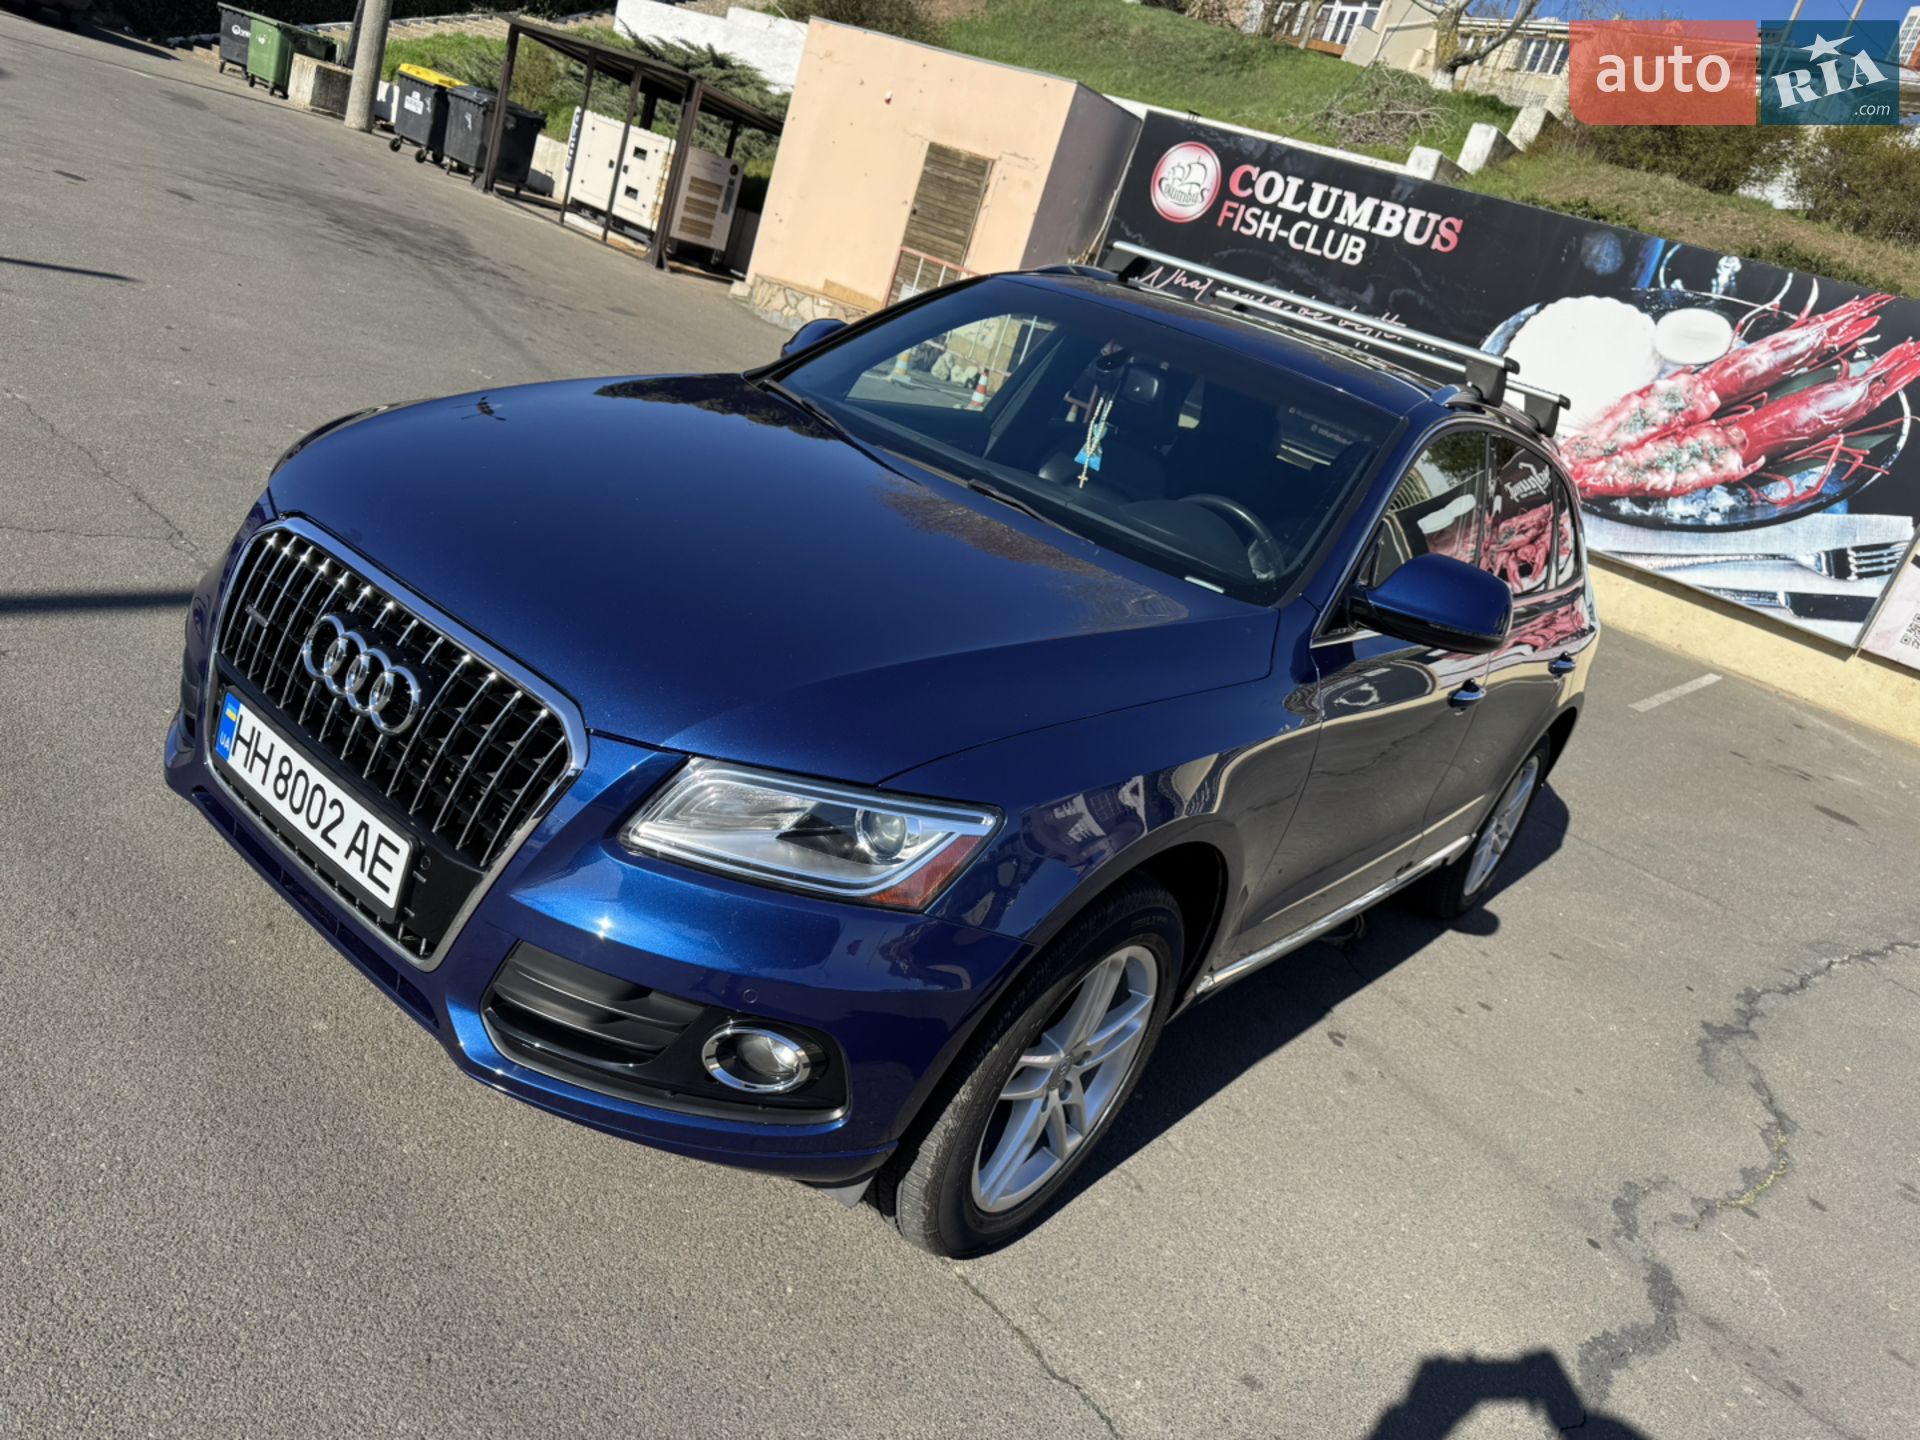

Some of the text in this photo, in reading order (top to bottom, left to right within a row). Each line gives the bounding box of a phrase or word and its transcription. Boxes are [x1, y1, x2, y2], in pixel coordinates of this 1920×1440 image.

[1216, 200, 1367, 266] FISH-CLUB
[1228, 163, 1464, 253] COLUMBUS
[219, 731, 231, 752] UA
[231, 713, 400, 894] HH 8002 AE
